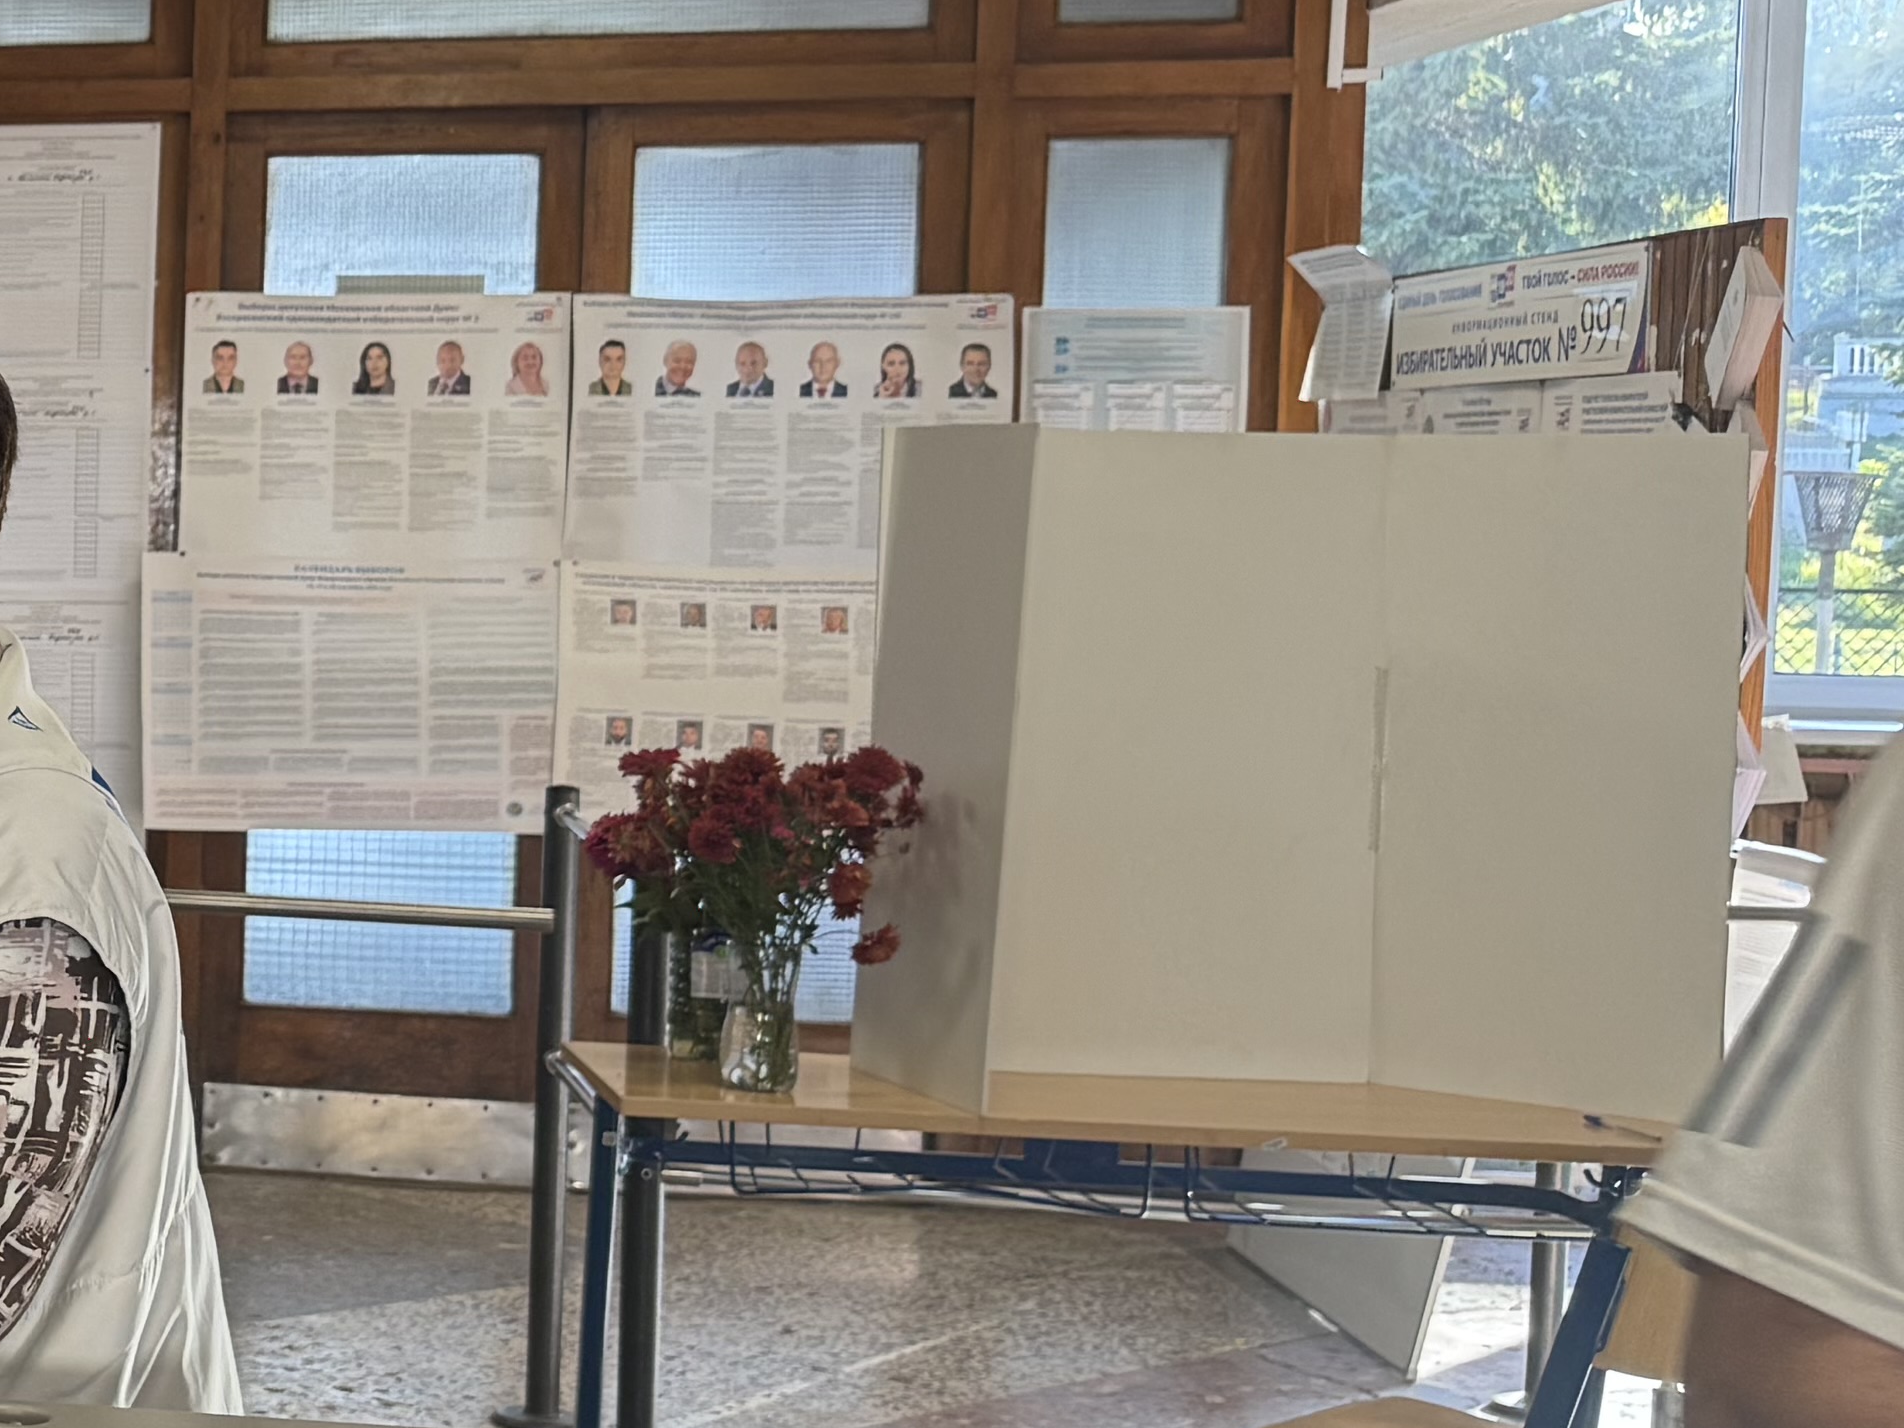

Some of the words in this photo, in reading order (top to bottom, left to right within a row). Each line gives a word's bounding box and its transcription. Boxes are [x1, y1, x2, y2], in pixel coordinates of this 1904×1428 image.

[1522, 270, 1542, 290] ТВОЙ
[1542, 269, 1569, 287] ГОЛОС
[1531, 309, 1559, 325] СТЕНД
[1396, 338, 1487, 375] ИЗБИРАТЕЛЬНЫЙ
[1491, 337, 1551, 368] УЧАСТОК
[1557, 326, 1577, 362] №
[1581, 296, 1628, 354] 997
